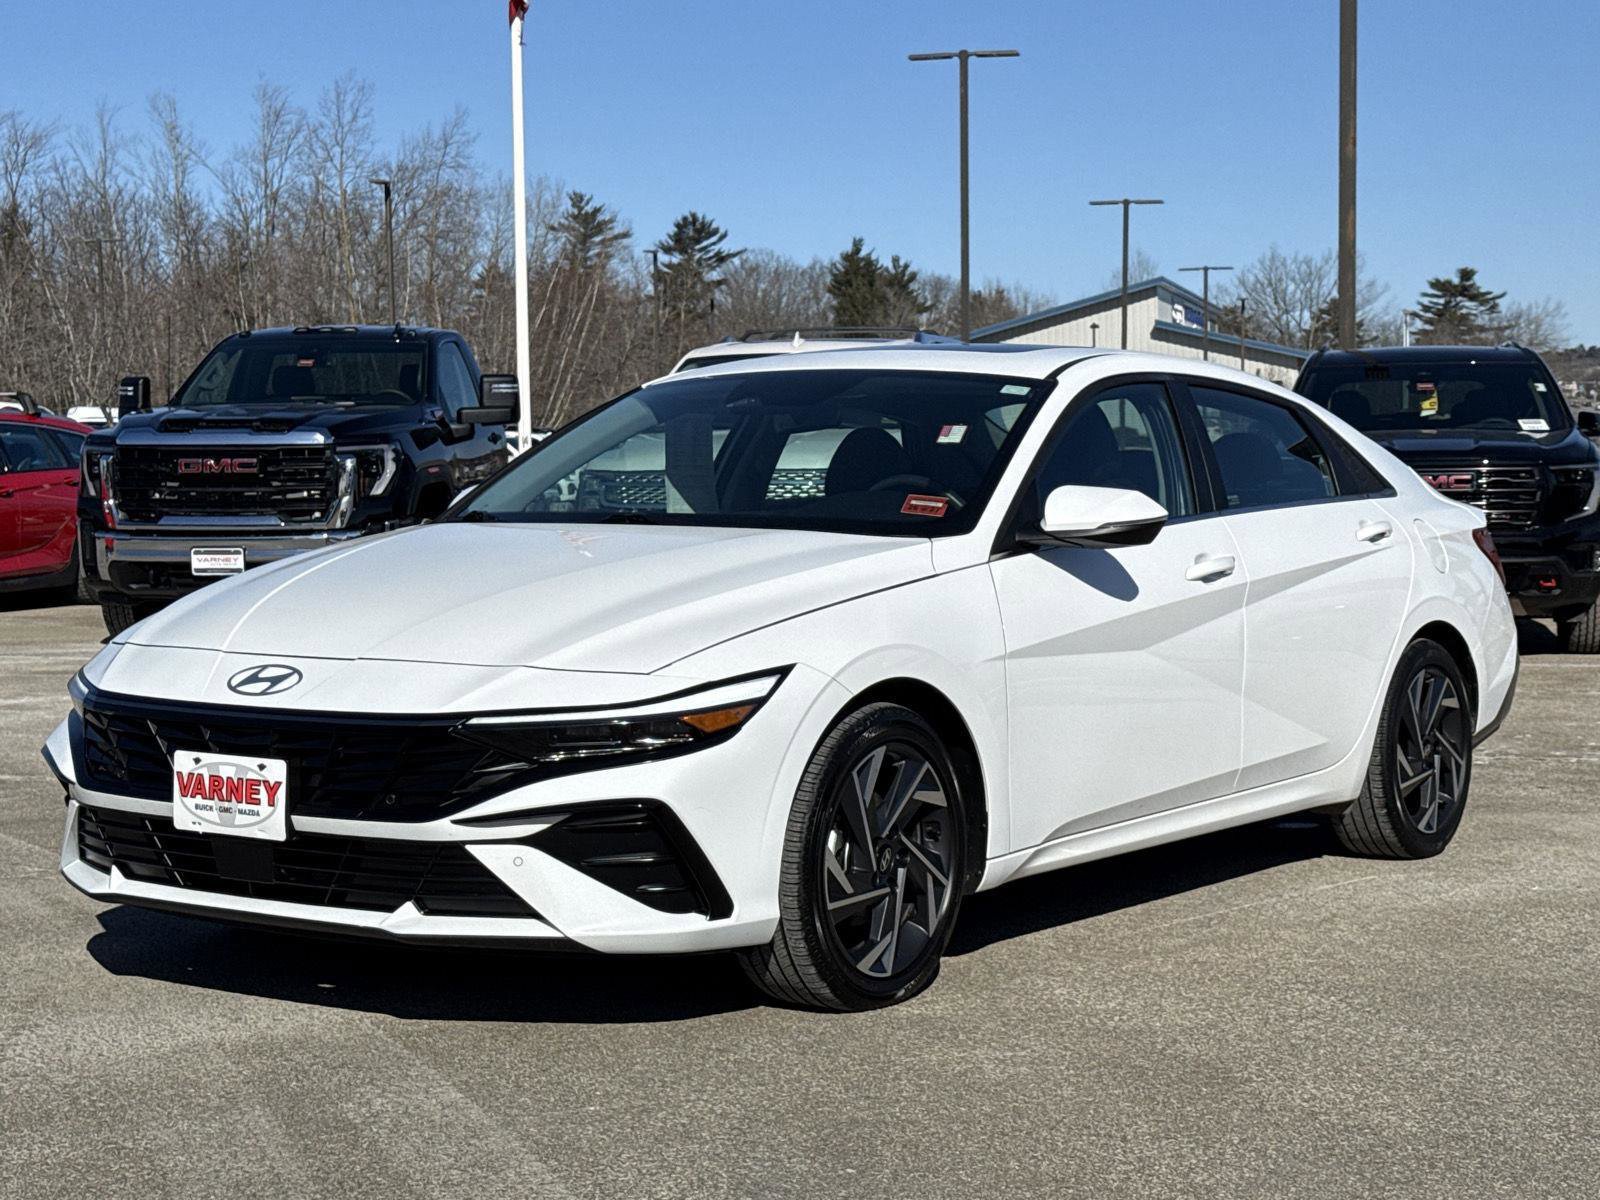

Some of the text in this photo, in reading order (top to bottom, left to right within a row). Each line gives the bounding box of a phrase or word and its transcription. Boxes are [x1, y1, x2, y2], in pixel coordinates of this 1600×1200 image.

[178, 458, 258, 473] GMC
[1422, 474, 1472, 488] MC
[176, 771, 282, 807] VARNEY
[194, 803, 260, 817] BUICK GMC MAZDA
